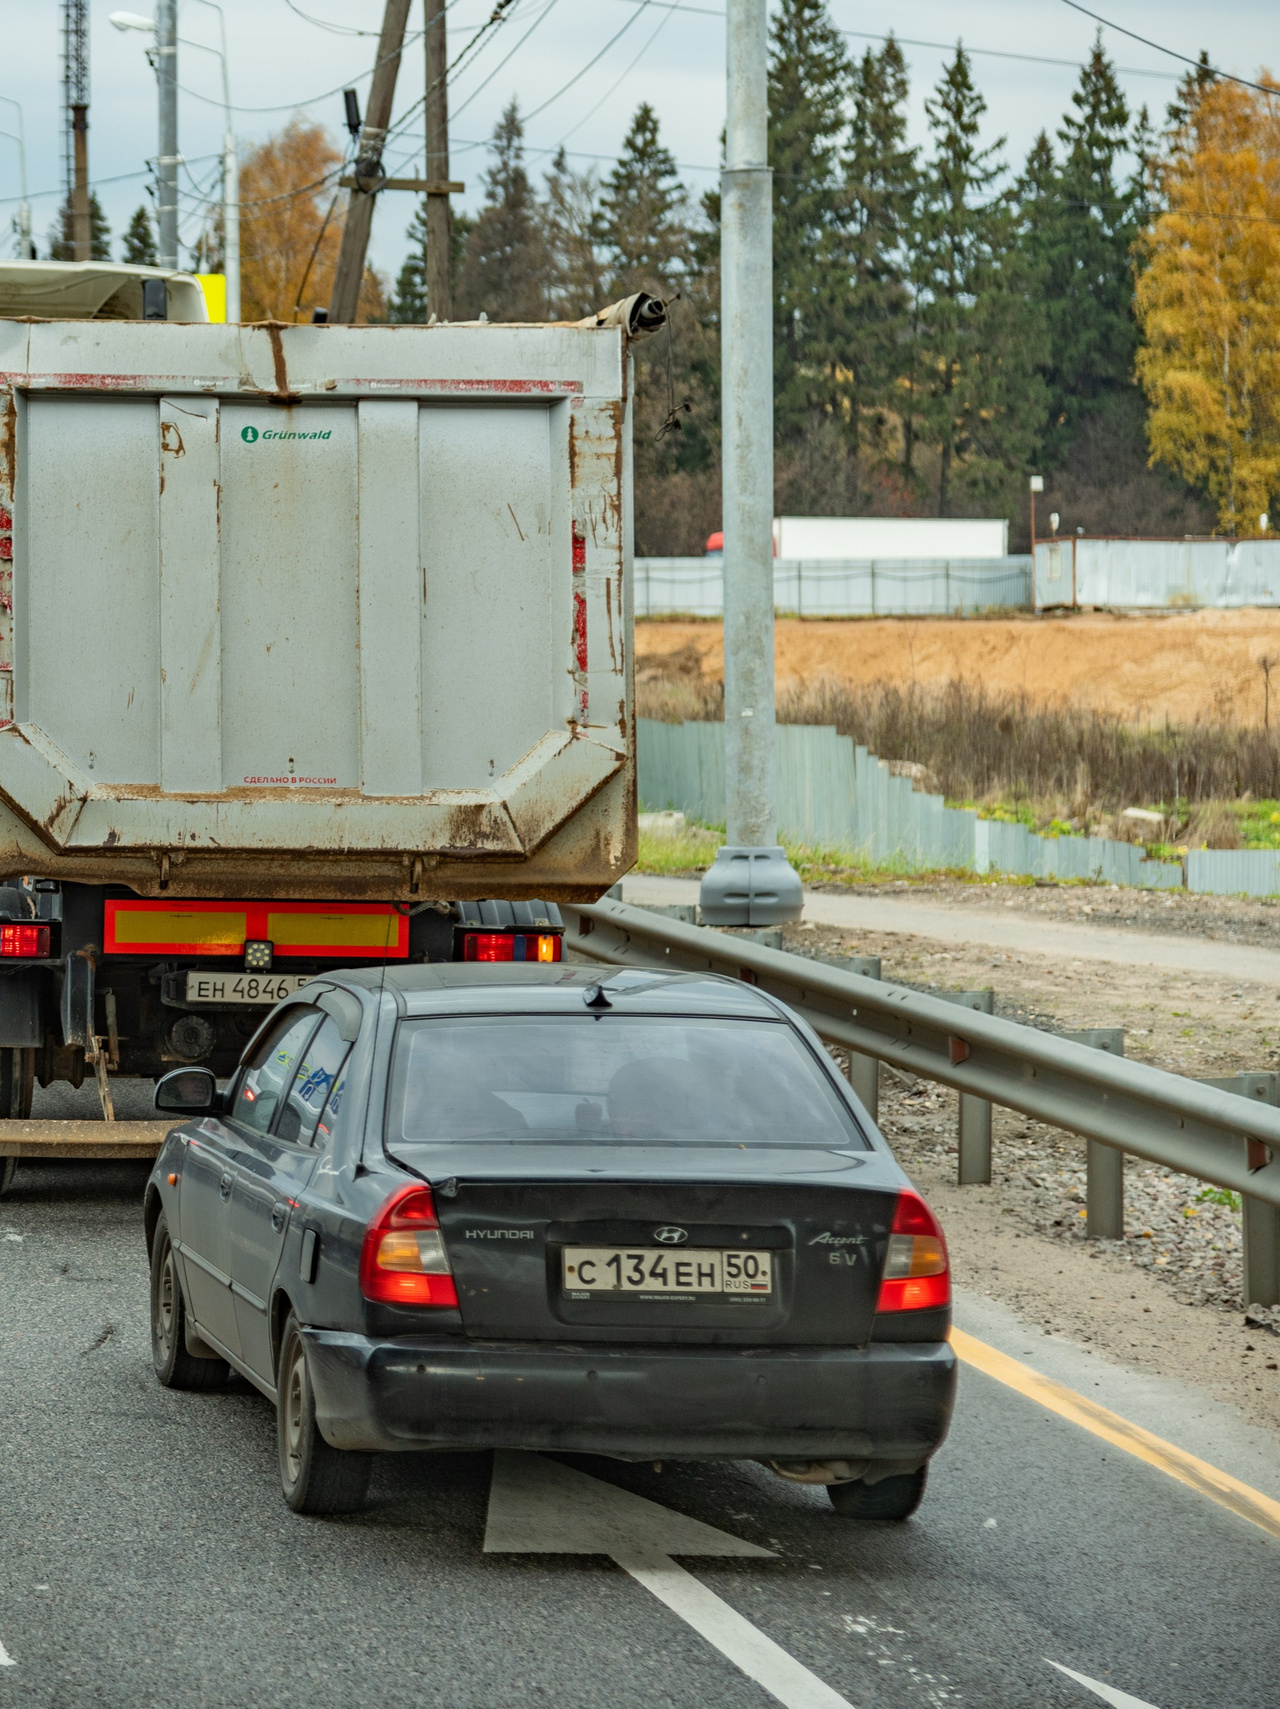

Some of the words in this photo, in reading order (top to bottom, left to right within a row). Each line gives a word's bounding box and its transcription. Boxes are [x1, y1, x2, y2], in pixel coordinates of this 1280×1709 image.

[261, 430, 332, 440] Grünwald
[243, 776, 289, 784] СДЕЛАНО
[291, 776, 297, 784] В
[465, 1229, 534, 1239] HYUNDAI
[808, 1231, 870, 1246] Accent
[726, 1254, 759, 1278] 50
[725, 1280, 750, 1289] RUS
